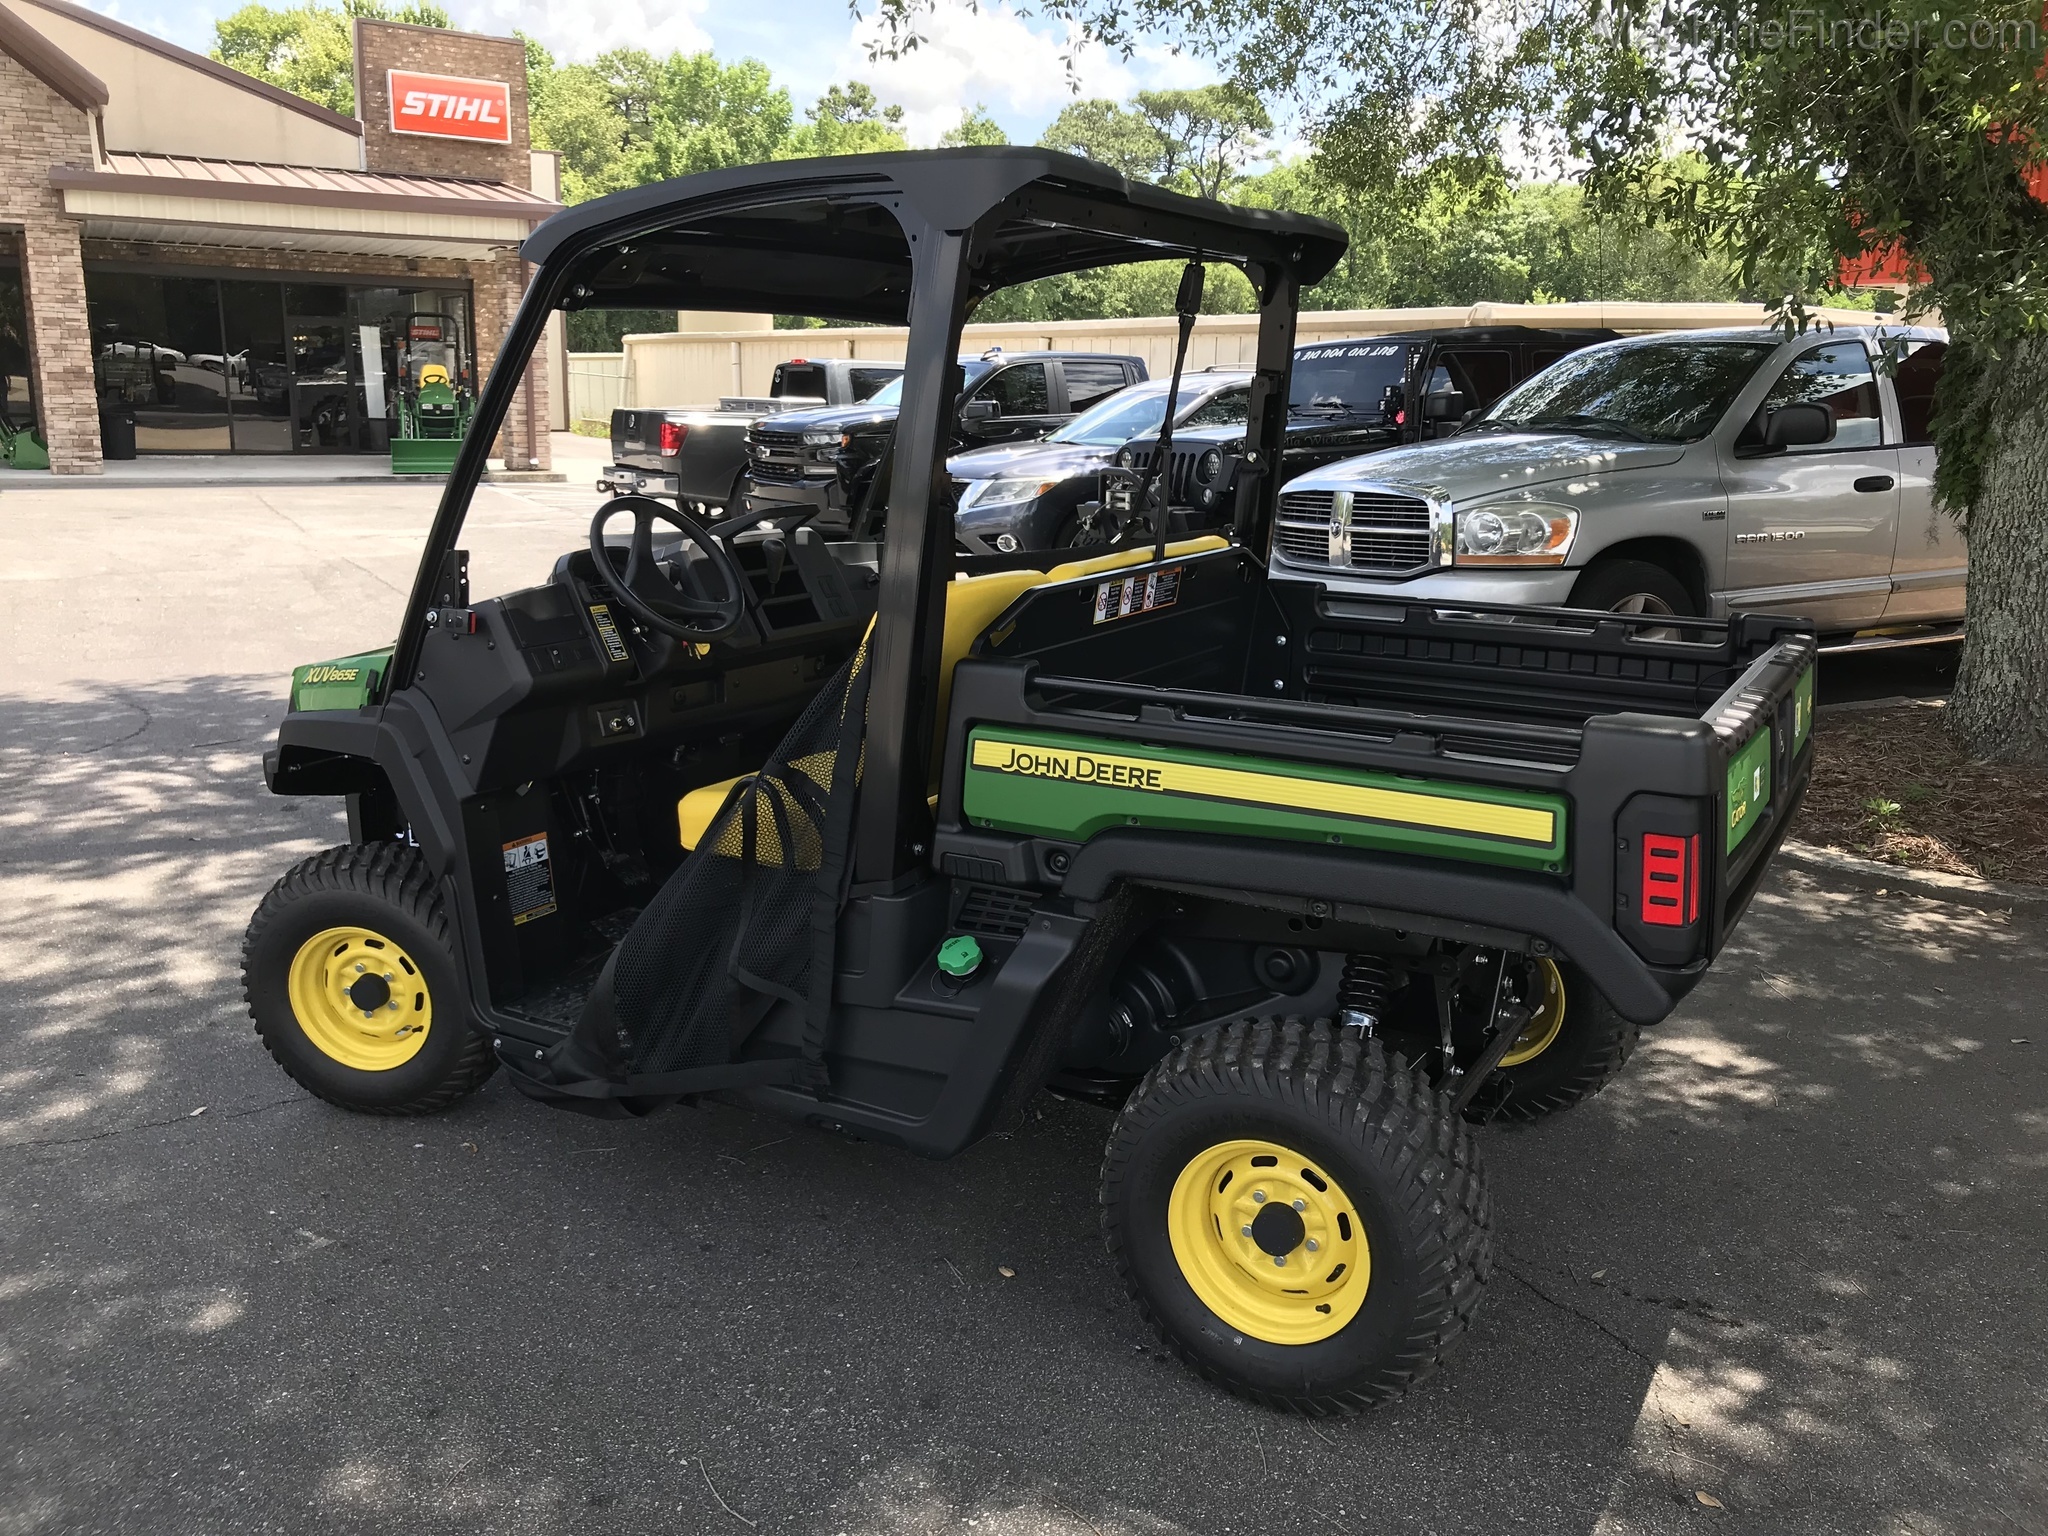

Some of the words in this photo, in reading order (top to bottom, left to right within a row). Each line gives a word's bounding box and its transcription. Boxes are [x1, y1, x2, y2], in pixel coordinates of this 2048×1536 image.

[401, 91, 500, 124] STIHL
[1300, 350, 1321, 361] DIE
[1321, 347, 1347, 358] YOU
[1348, 347, 1371, 356] DID
[1369, 345, 1399, 356] BUT
[1771, 531, 1805, 542] 1500
[303, 665, 359, 683] XUV865E
[1001, 748, 1069, 776] JOHN
[1076, 756, 1162, 788] DEERE
